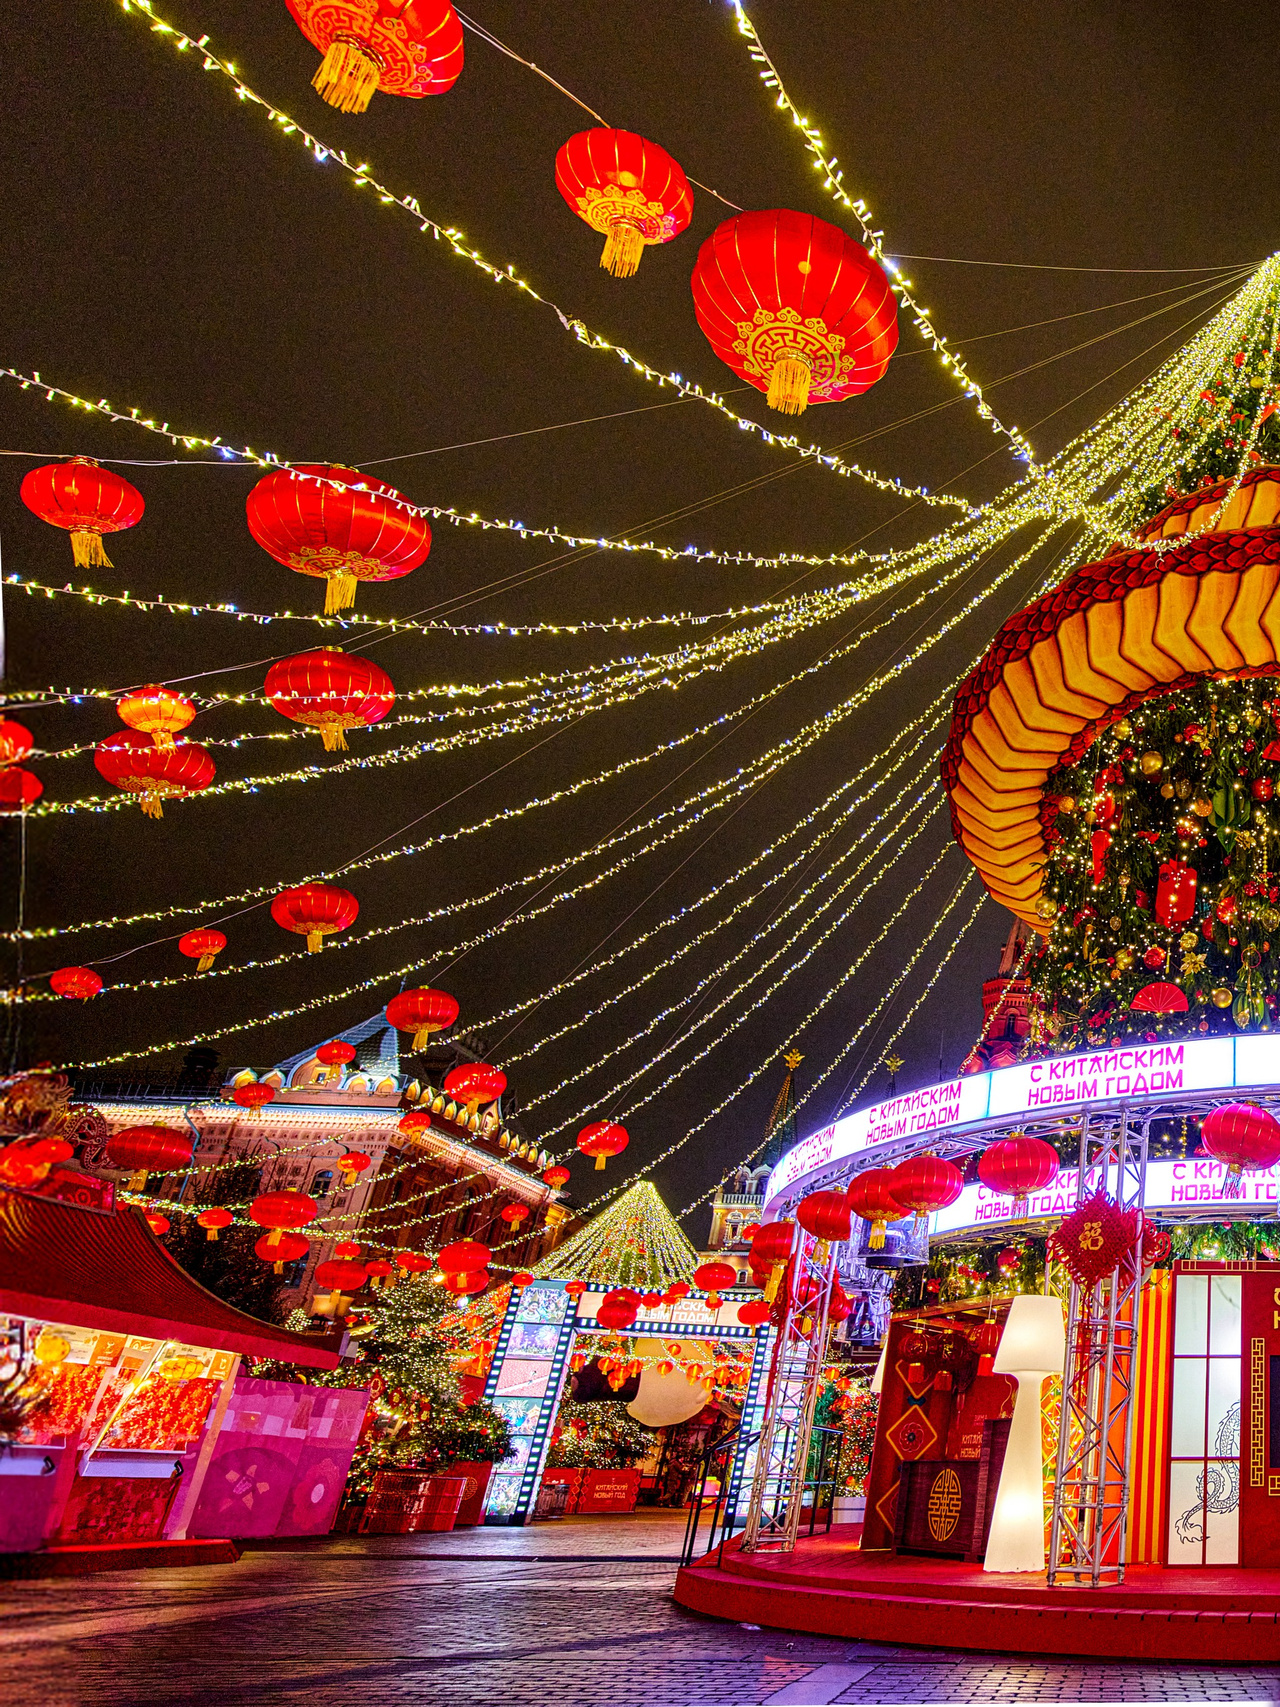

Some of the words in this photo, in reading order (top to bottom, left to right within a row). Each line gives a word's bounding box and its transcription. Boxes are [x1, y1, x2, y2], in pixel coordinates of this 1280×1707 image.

[1030, 1065, 1043, 1083] С
[1049, 1045, 1184, 1080] КИТАЙСКИМ
[869, 1108, 877, 1124] С
[879, 1080, 962, 1120] КИТАЙСКИМ
[1027, 1078, 1098, 1106] НОВЫМ
[1105, 1069, 1183, 1095] ГОДОМ
[865, 1118, 907, 1146] НОВЫМ
[910, 1103, 960, 1131] ГОДОМ
[1172, 1163, 1187, 1180] С
[977, 1185, 986, 1199] С
